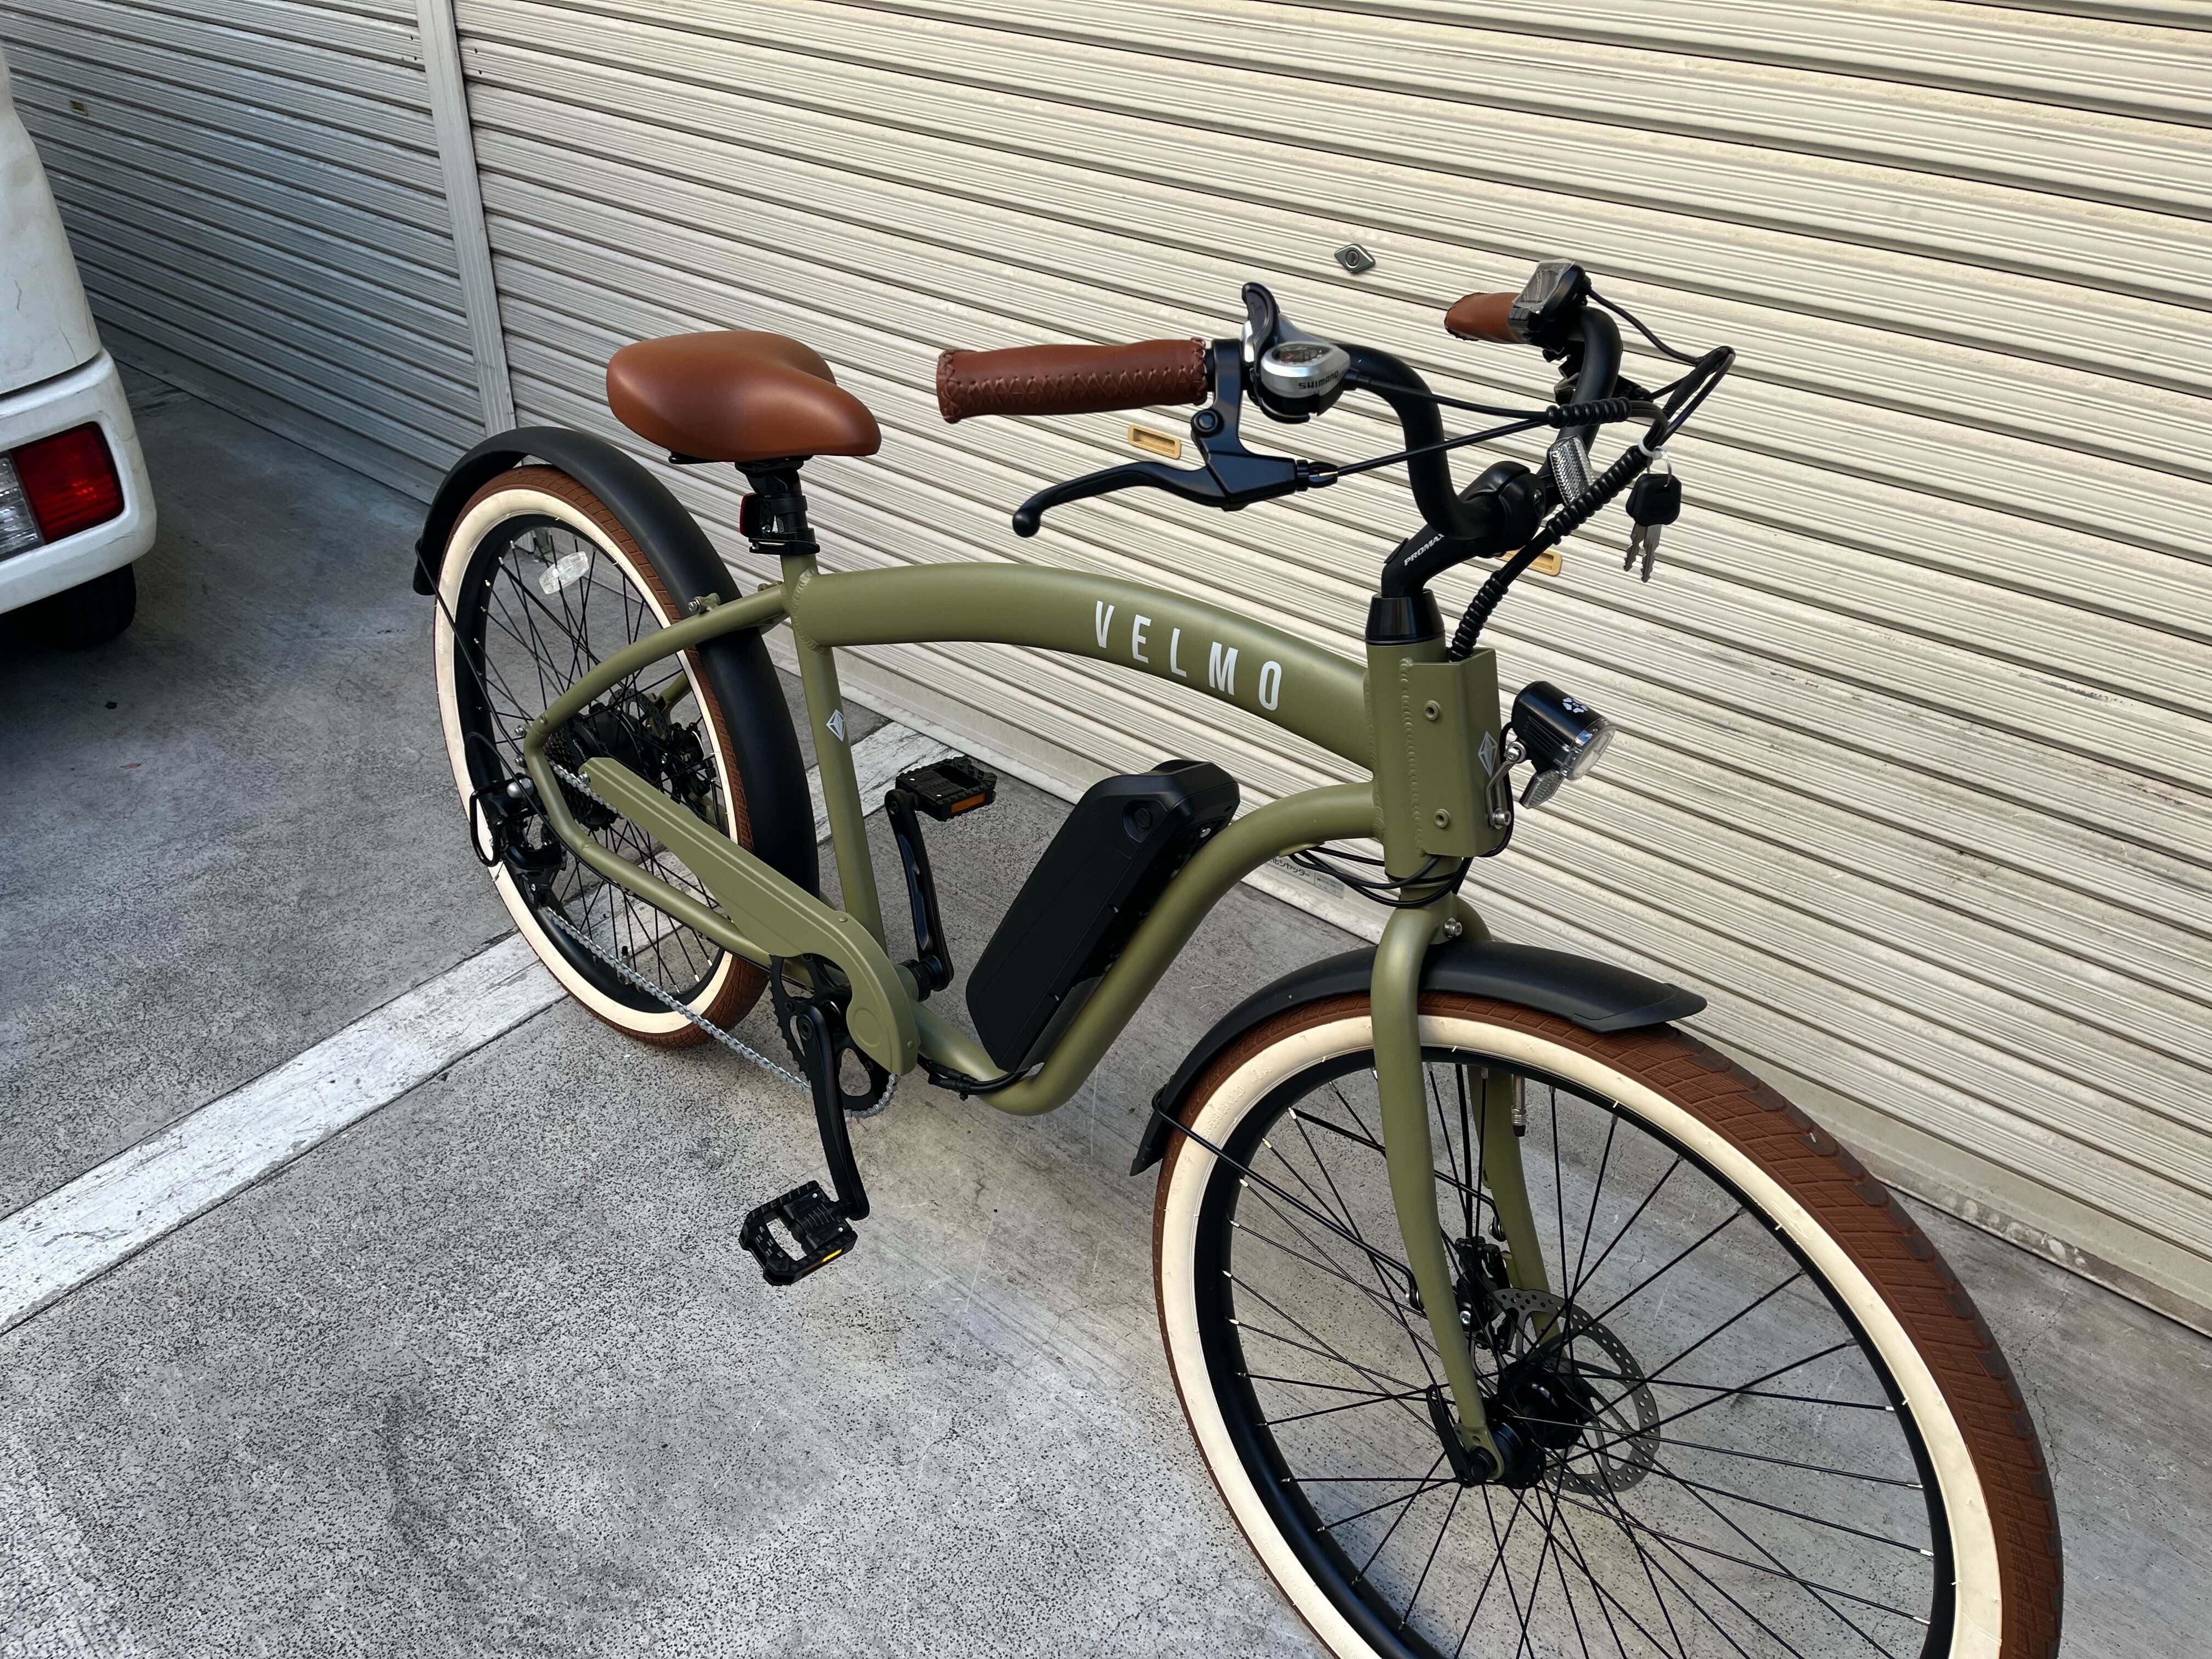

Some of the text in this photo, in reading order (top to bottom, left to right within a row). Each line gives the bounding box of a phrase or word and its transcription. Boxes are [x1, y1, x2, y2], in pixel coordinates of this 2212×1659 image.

[1298, 370, 1339, 390] SHIMANO
[1095, 600, 1282, 711] VELMO
[1269, 857, 1311, 877] 化シャッター
